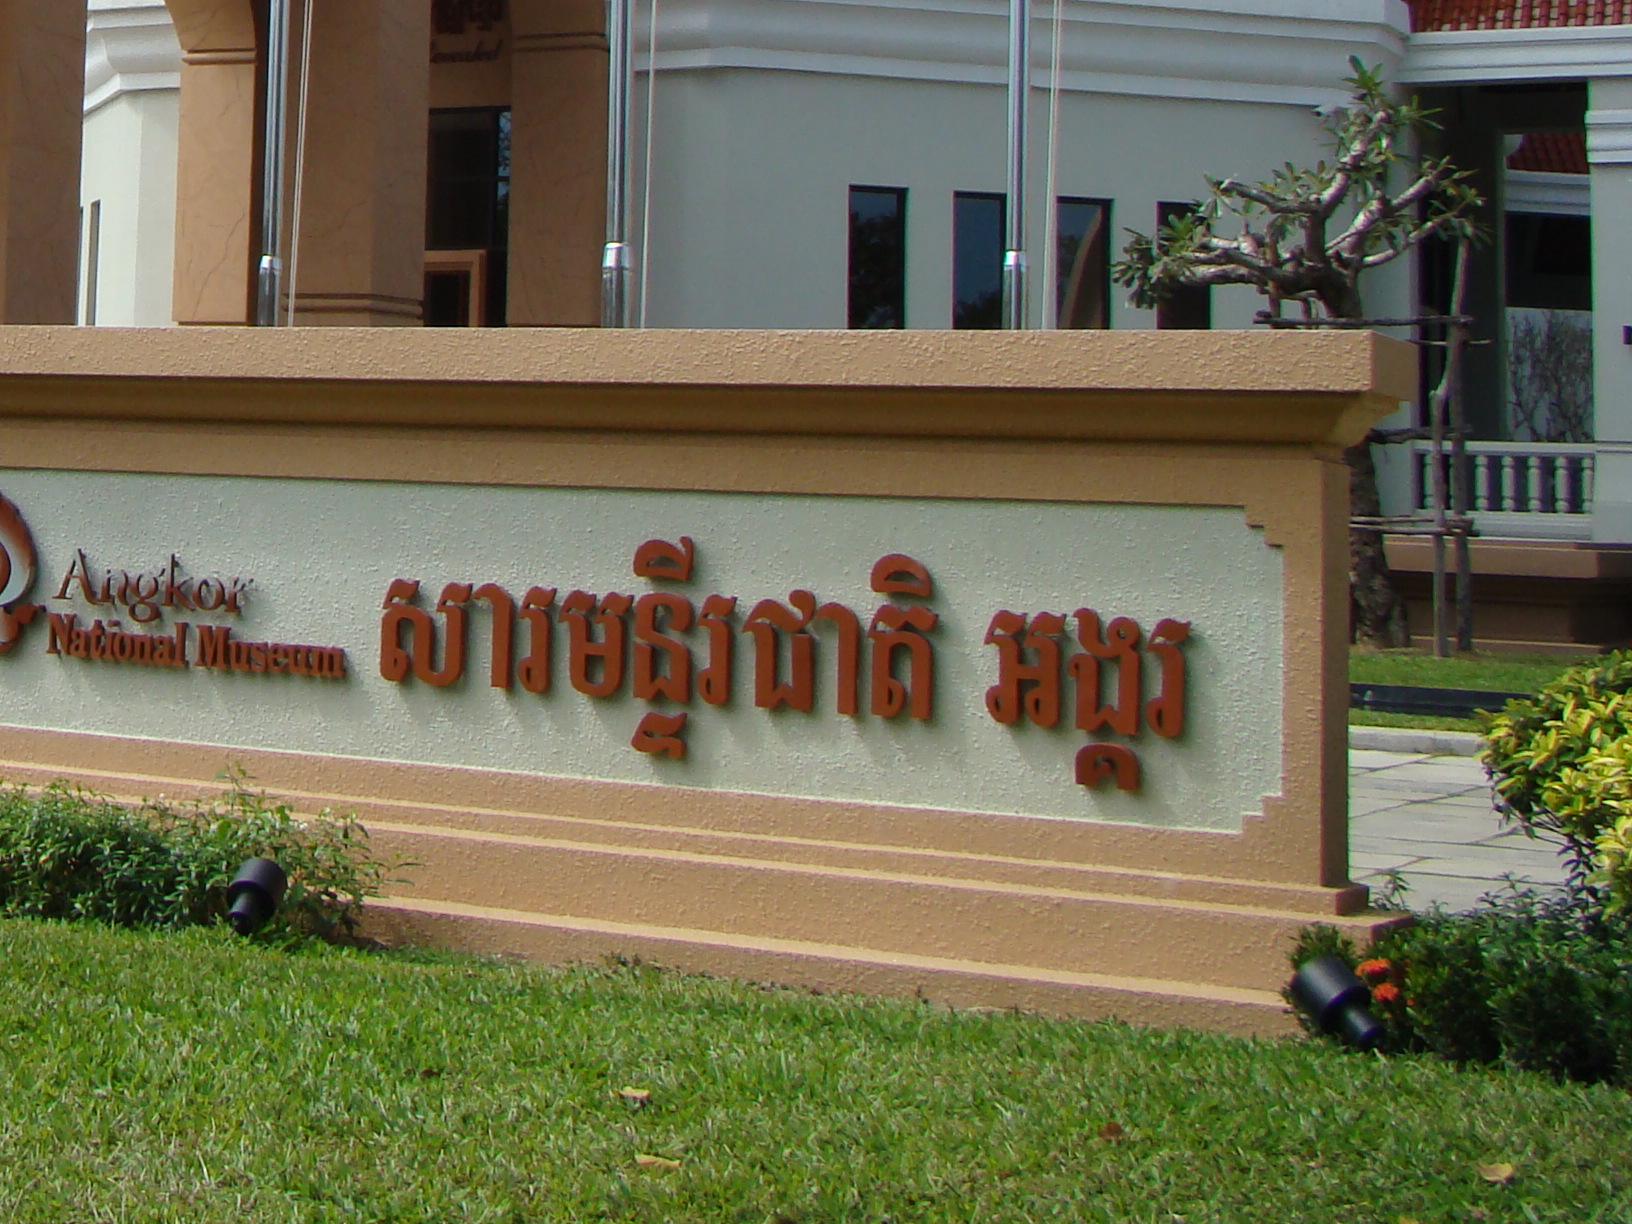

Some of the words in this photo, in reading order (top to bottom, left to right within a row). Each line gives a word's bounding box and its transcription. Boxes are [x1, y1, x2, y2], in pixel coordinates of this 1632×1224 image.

[52, 548, 255, 623] Angkor
[46, 613, 189, 668] National
[195, 624, 347, 677] Museum
[984, 607, 1192, 792] អង្គរ
